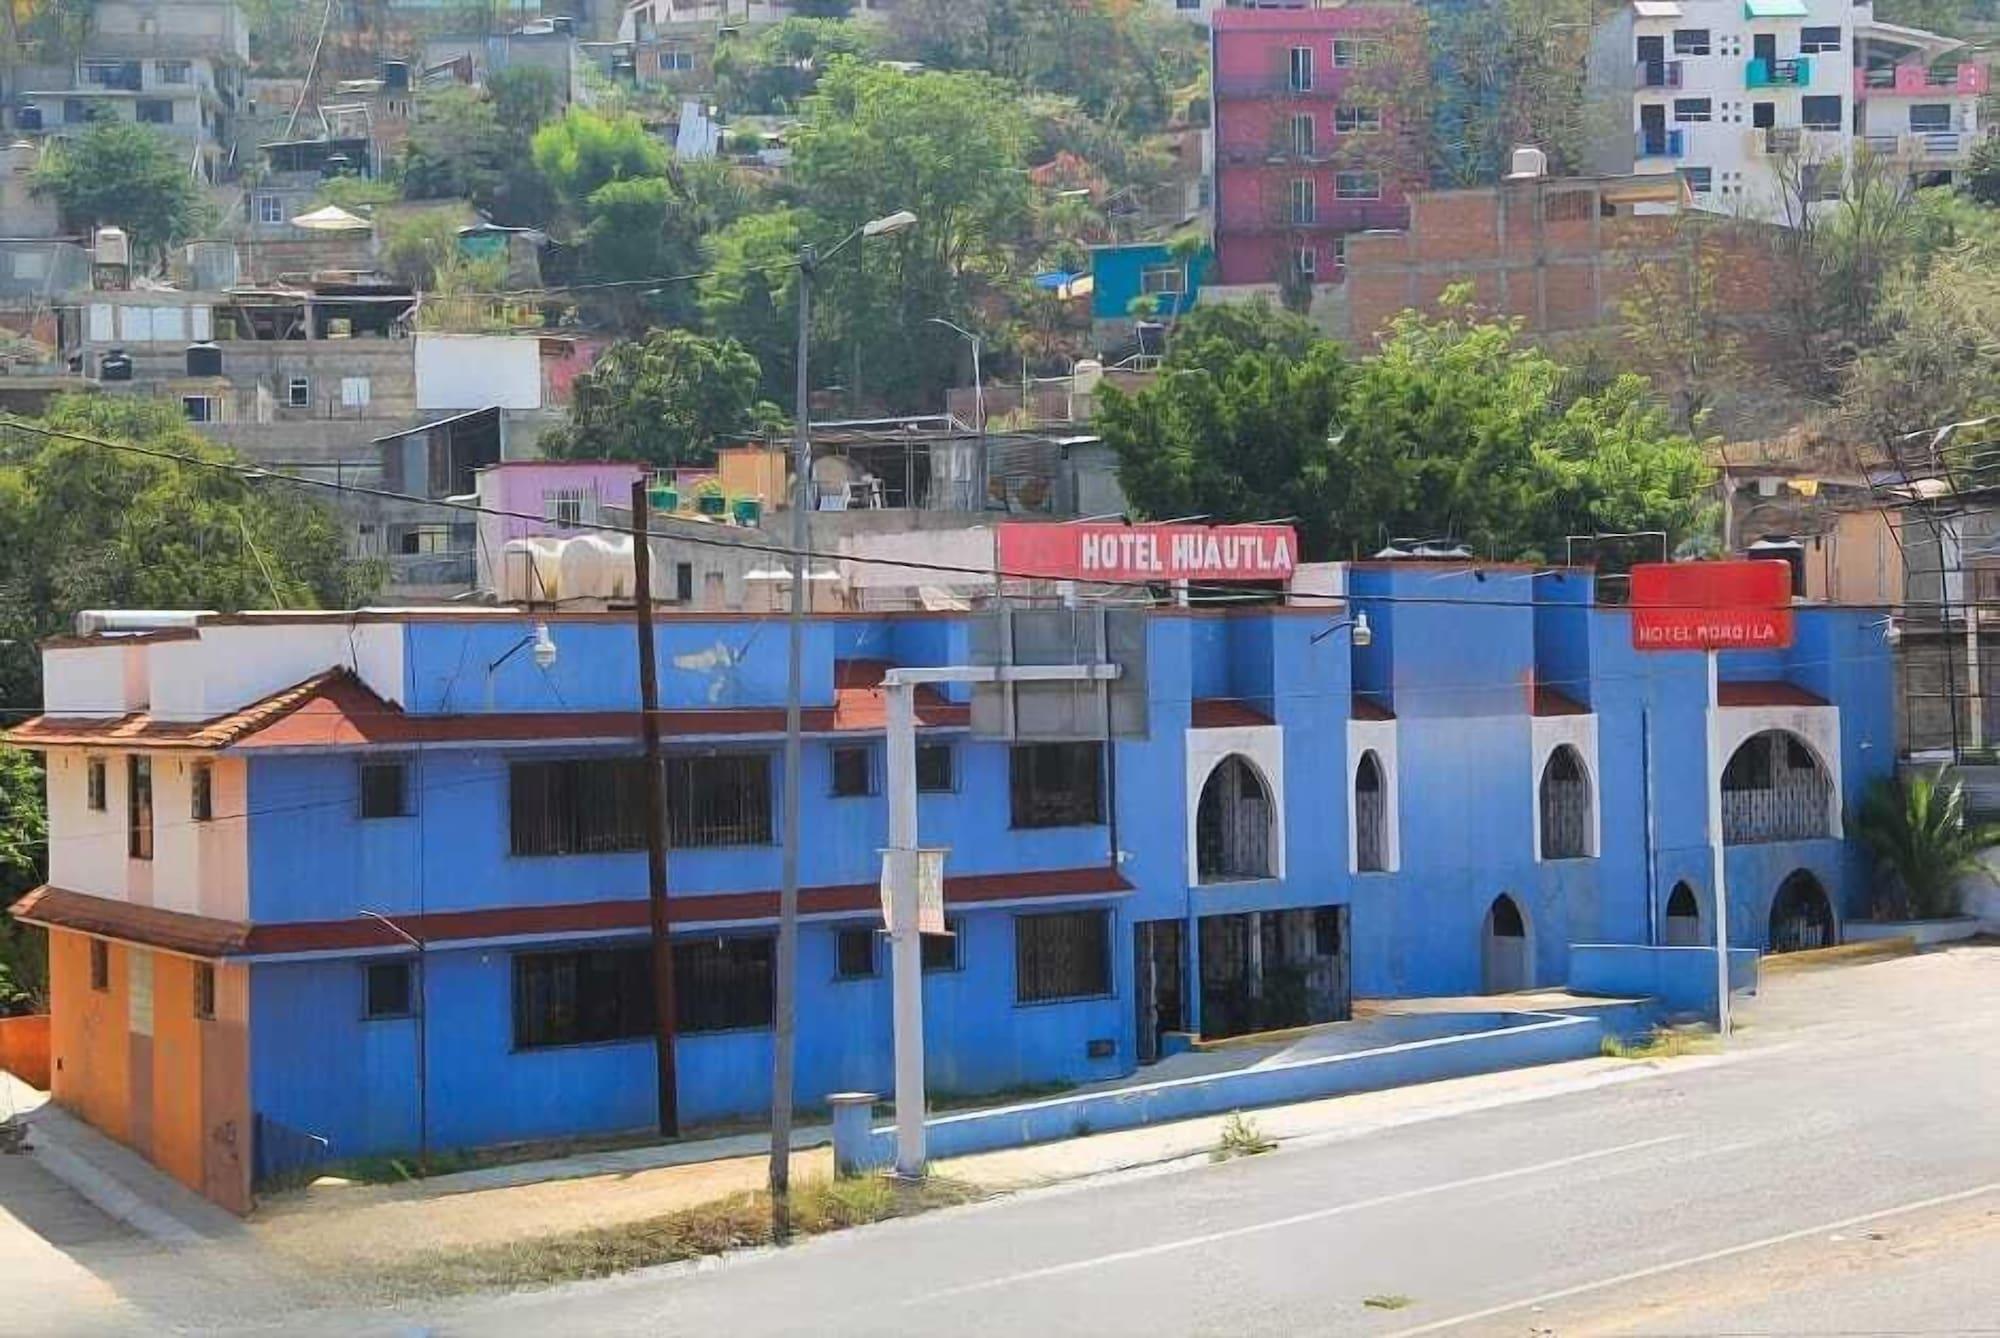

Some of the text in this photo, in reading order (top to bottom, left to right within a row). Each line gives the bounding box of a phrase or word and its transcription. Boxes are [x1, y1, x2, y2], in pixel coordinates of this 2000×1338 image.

[1081, 532, 1293, 571] HOTEL HUAUTLA
[1639, 625, 1693, 642] HOTEL
